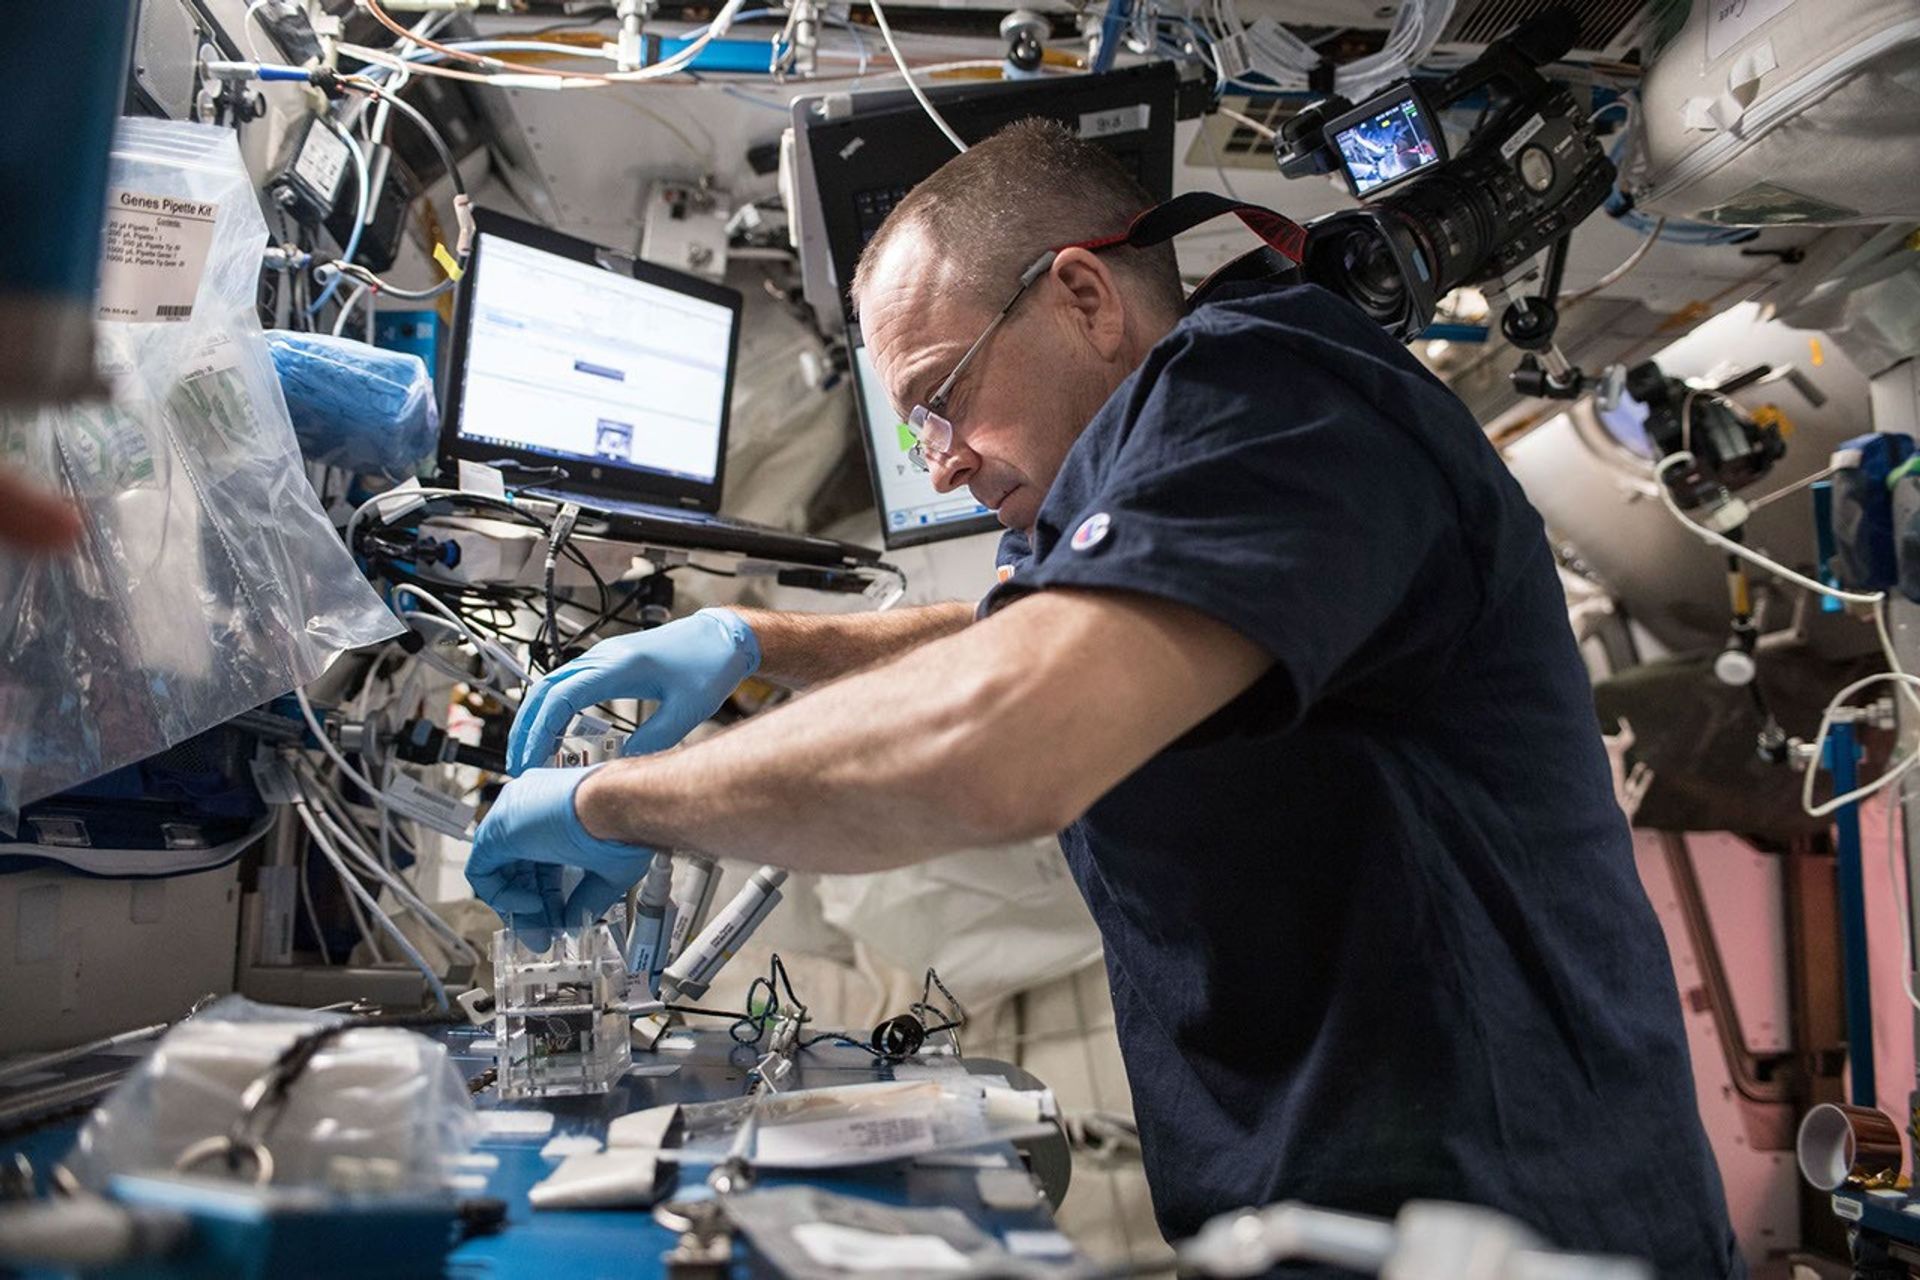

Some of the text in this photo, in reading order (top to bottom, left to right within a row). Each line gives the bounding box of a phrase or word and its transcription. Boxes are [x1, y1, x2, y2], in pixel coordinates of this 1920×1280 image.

[121, 193, 213, 216] Genes Pipette Kit
